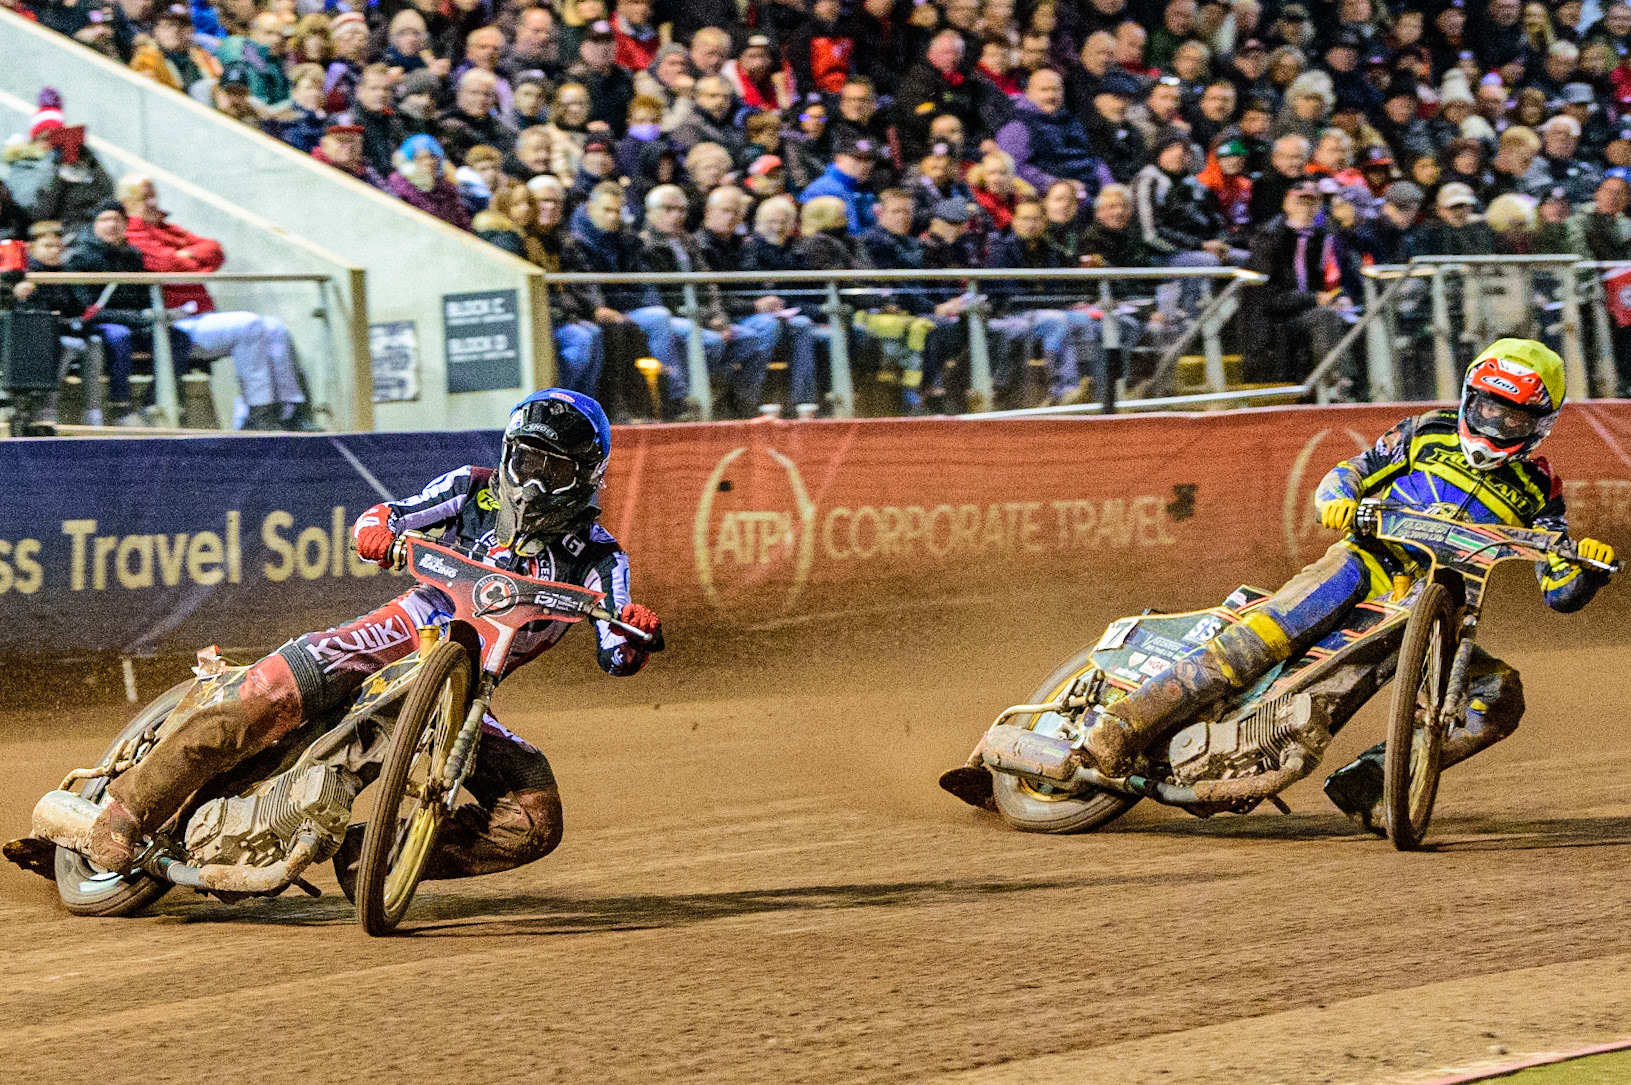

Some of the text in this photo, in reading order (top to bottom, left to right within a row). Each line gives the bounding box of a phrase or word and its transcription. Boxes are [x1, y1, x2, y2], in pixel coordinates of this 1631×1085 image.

[1483, 376, 1519, 394] Arai
[528, 424, 557, 439] SHOEI
[1052, 495, 1178, 550] TRAVEL
[62, 510, 242, 592] Travel
[418, 559, 459, 579] RACING
